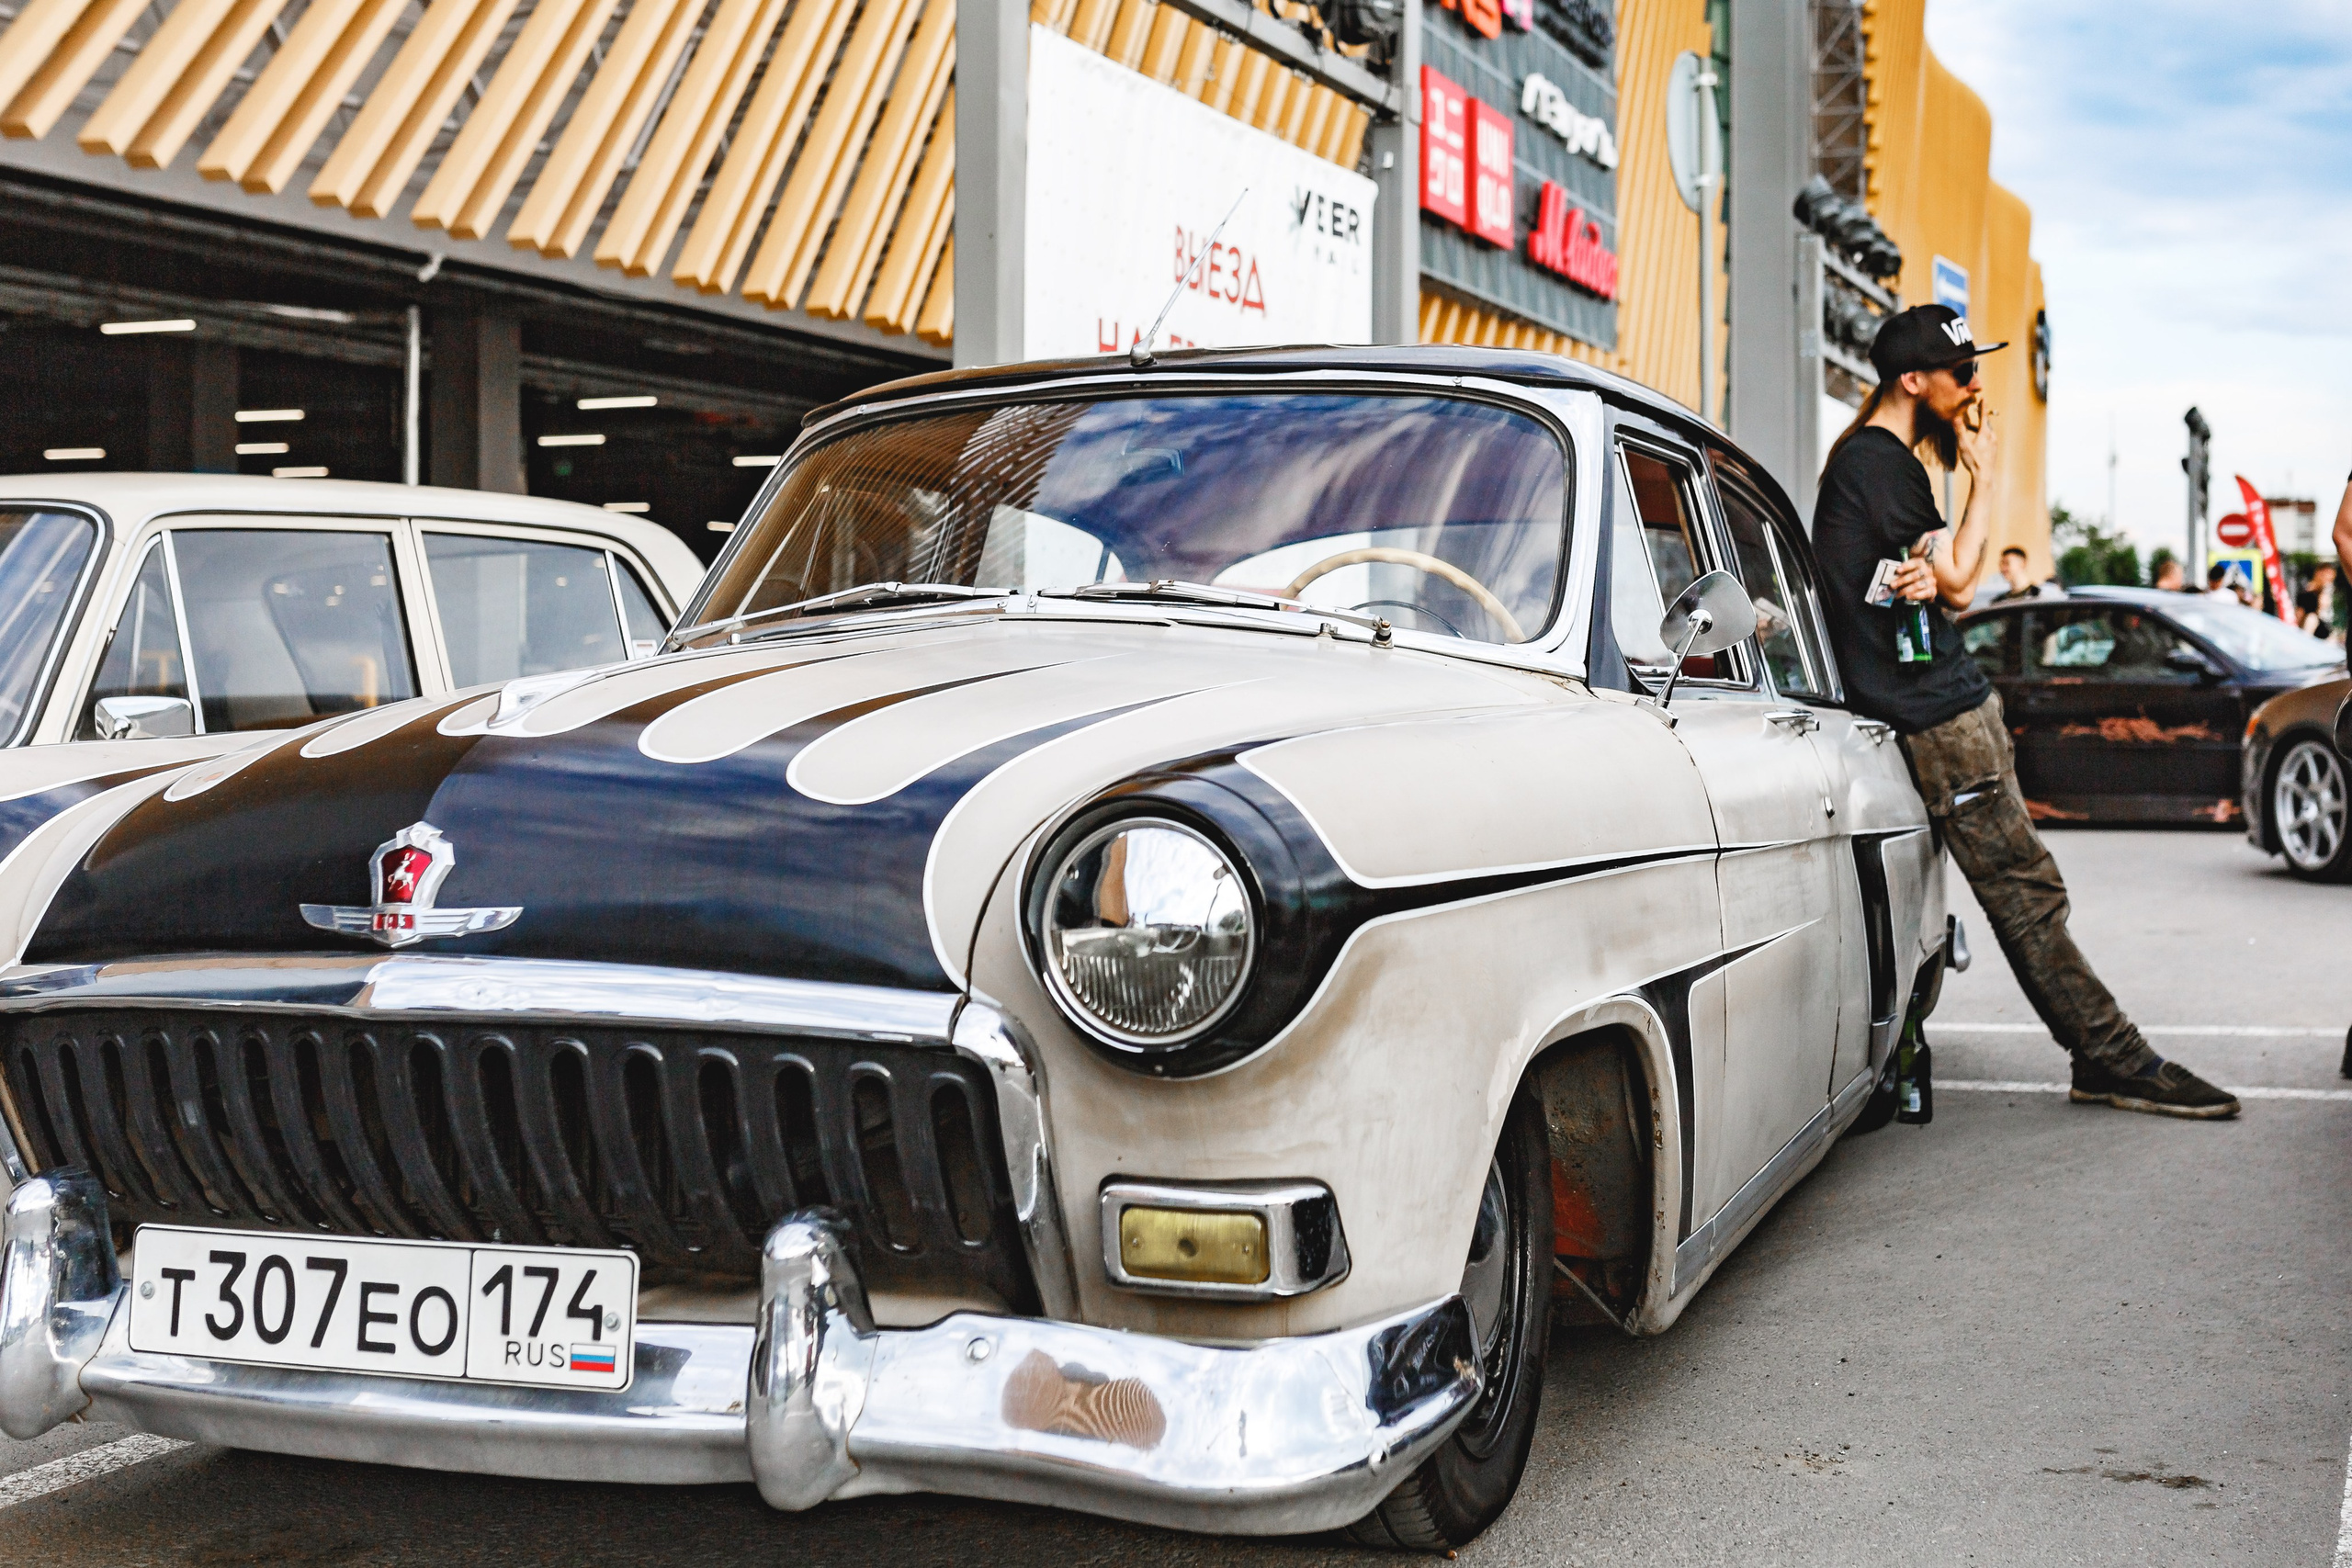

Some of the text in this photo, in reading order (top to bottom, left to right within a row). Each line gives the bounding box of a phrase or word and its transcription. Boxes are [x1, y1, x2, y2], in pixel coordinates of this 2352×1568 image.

[1174, 224, 1265, 318] ВЫЕЗД
[481, 1264, 603, 1341] 174
[504, 1340, 566, 1369] RUS
